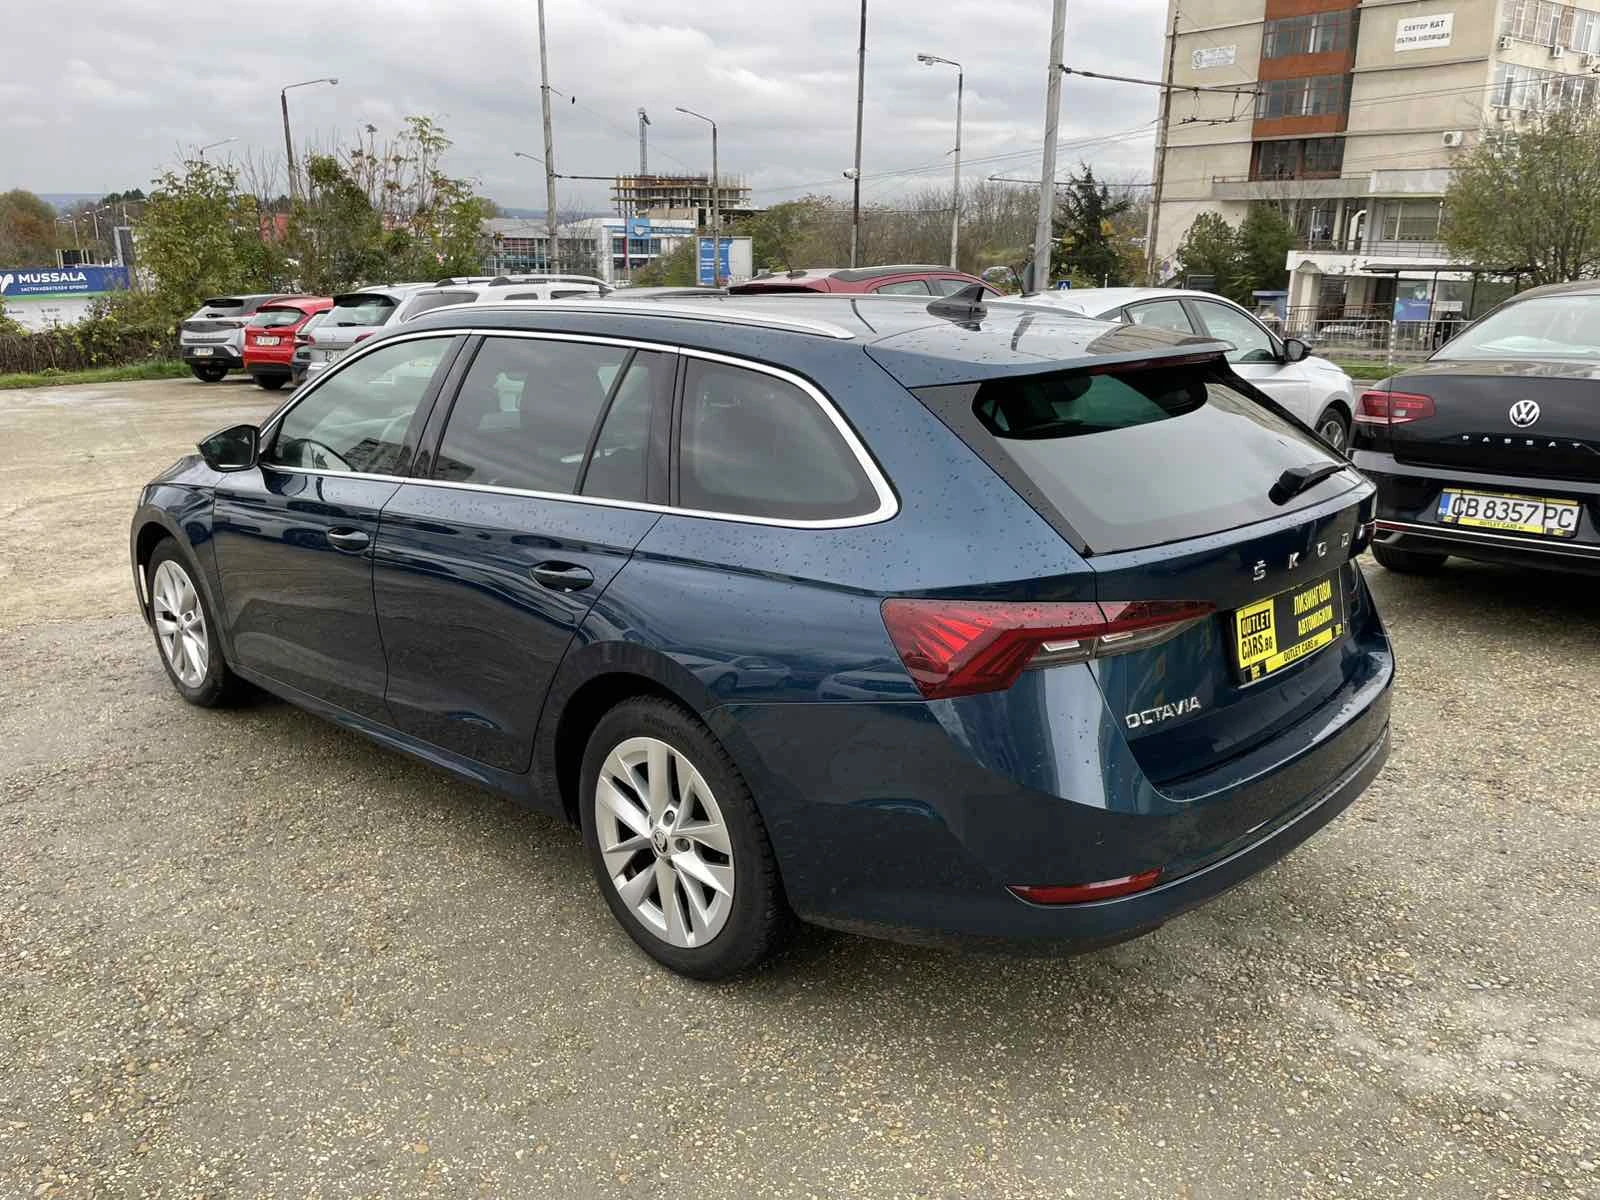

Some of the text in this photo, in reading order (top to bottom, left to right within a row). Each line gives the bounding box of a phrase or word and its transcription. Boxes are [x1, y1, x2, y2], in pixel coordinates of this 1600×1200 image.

[18, 271, 87, 284] MUSSALA
[1451, 497, 1575, 529] CB 8357 PC
[1241, 611, 1270, 637] OUTLET
[1125, 696, 1201, 729] OCTAVIA
